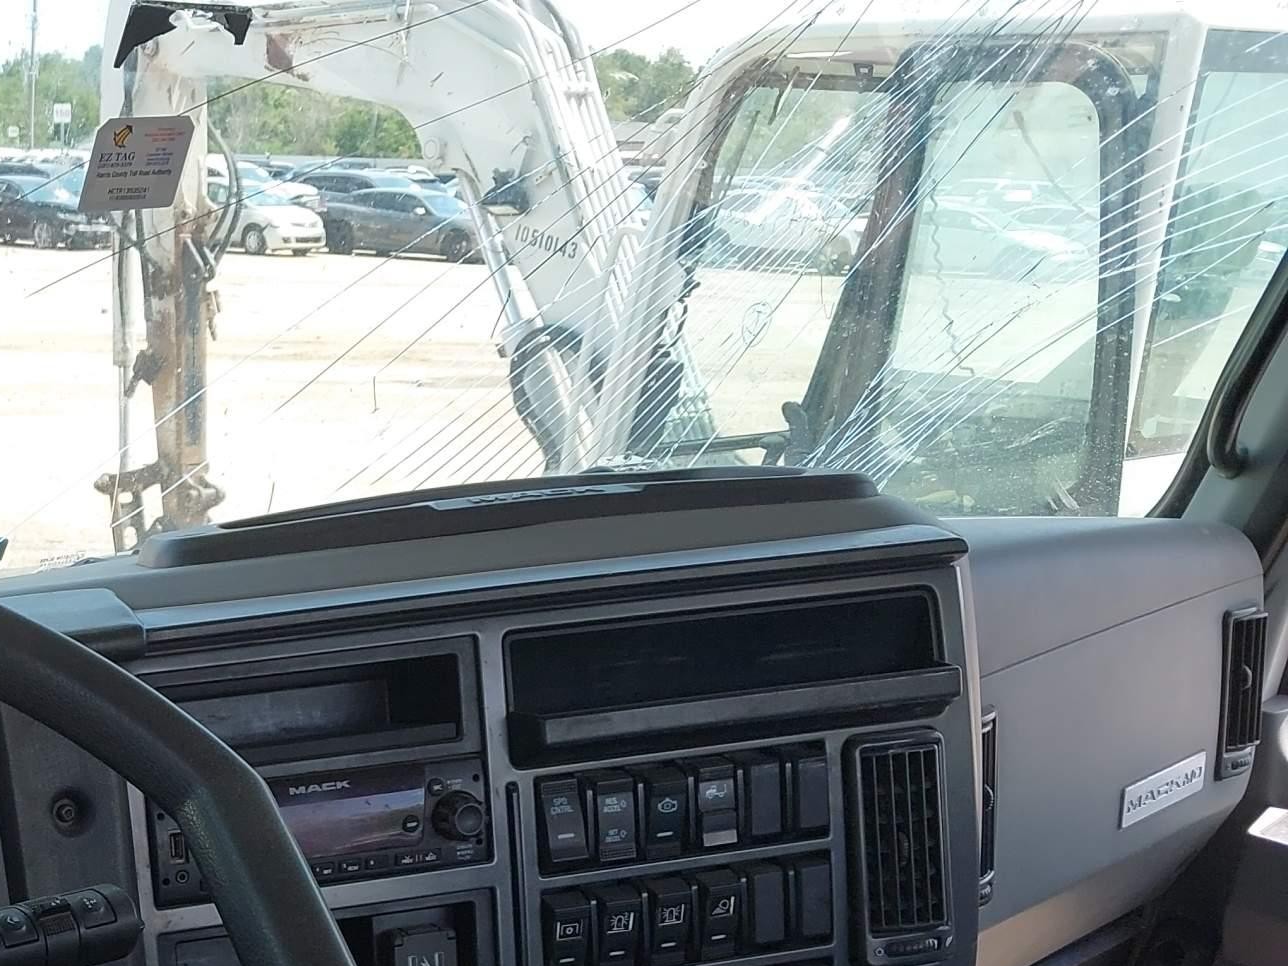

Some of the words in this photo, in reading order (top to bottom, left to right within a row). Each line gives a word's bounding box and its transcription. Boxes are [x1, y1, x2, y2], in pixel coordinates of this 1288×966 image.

[99, 152, 113, 162] EZ
[115, 151, 136, 161] TAG
[288, 779, 352, 796] MACK
